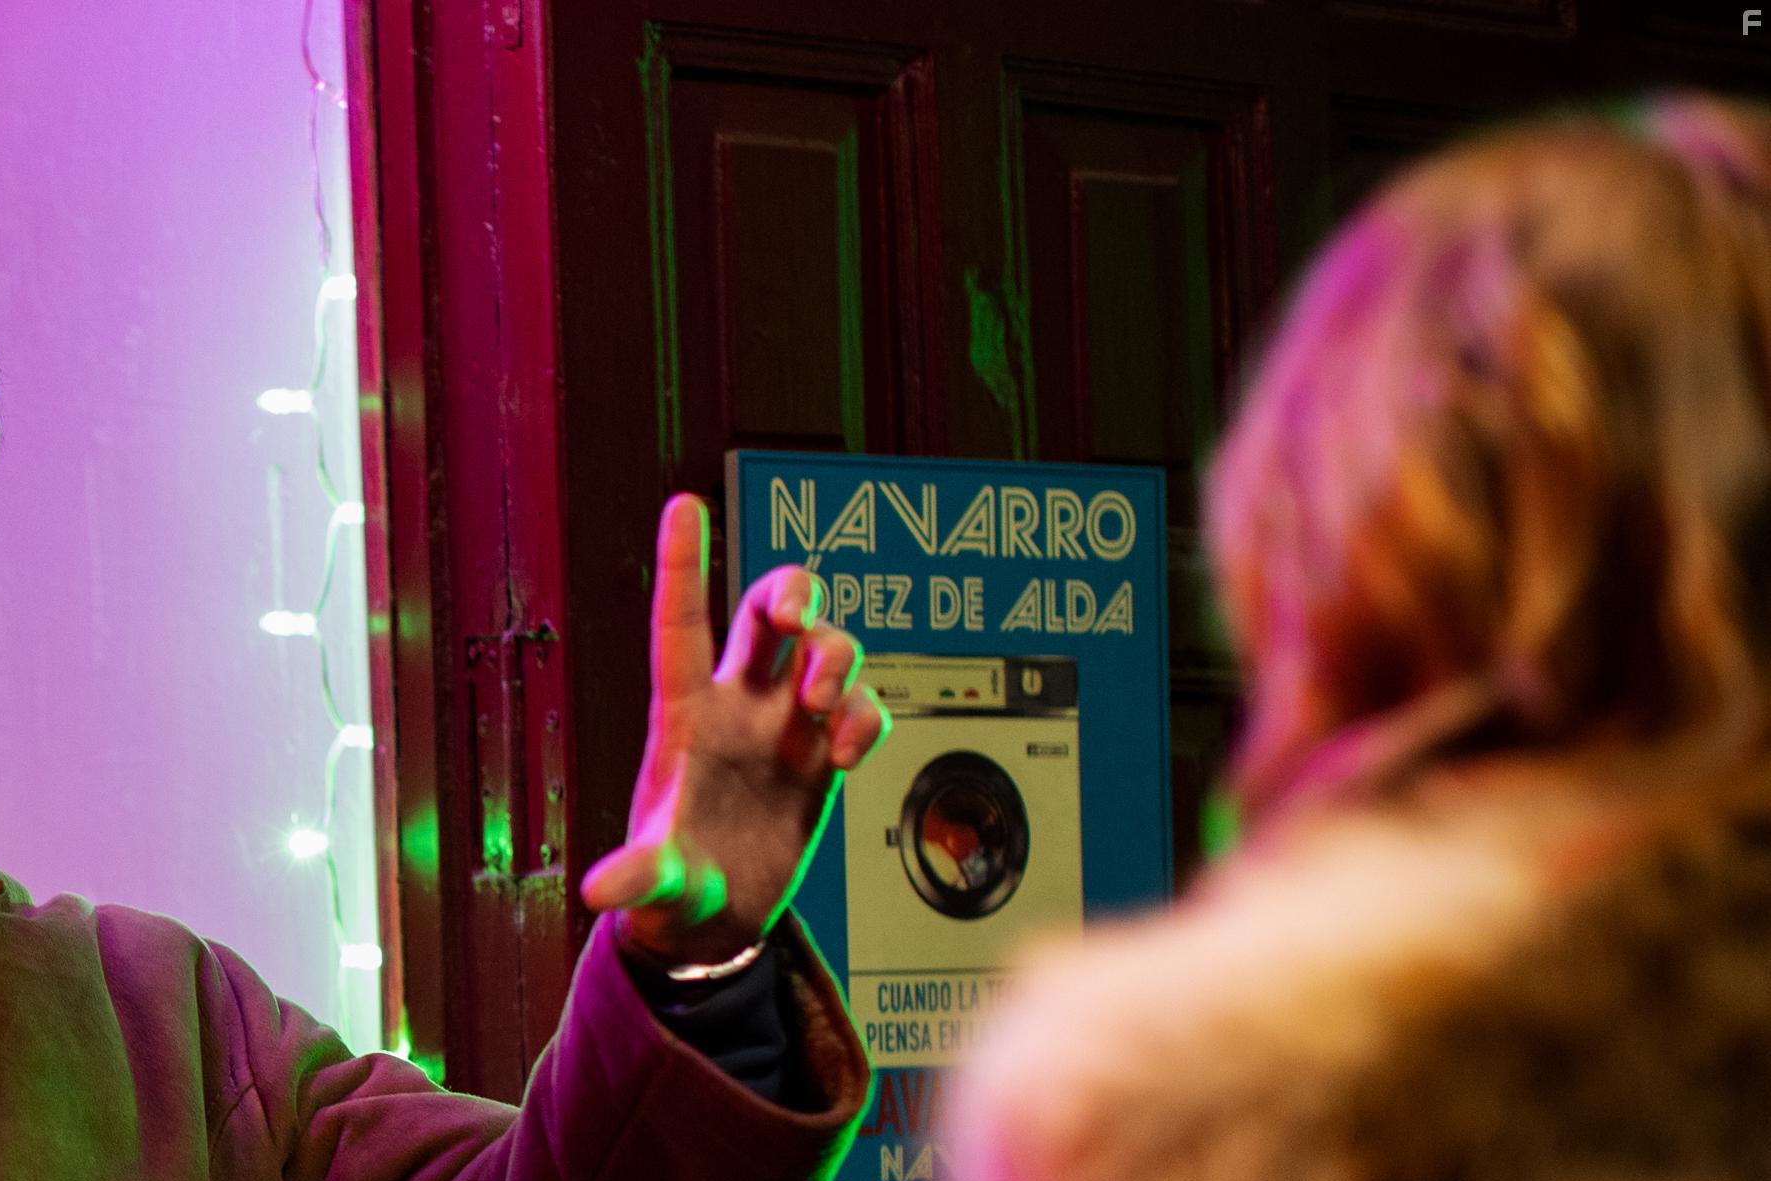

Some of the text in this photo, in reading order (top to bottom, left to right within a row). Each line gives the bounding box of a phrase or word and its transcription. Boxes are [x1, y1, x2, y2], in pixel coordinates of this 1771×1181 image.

[770, 477, 1136, 561] NAVARRO
[805, 554, 1134, 636] PEZ DE ALDA
[878, 981, 951, 1013] CUANDO
[866, 1021, 931, 1052] PIENSA
